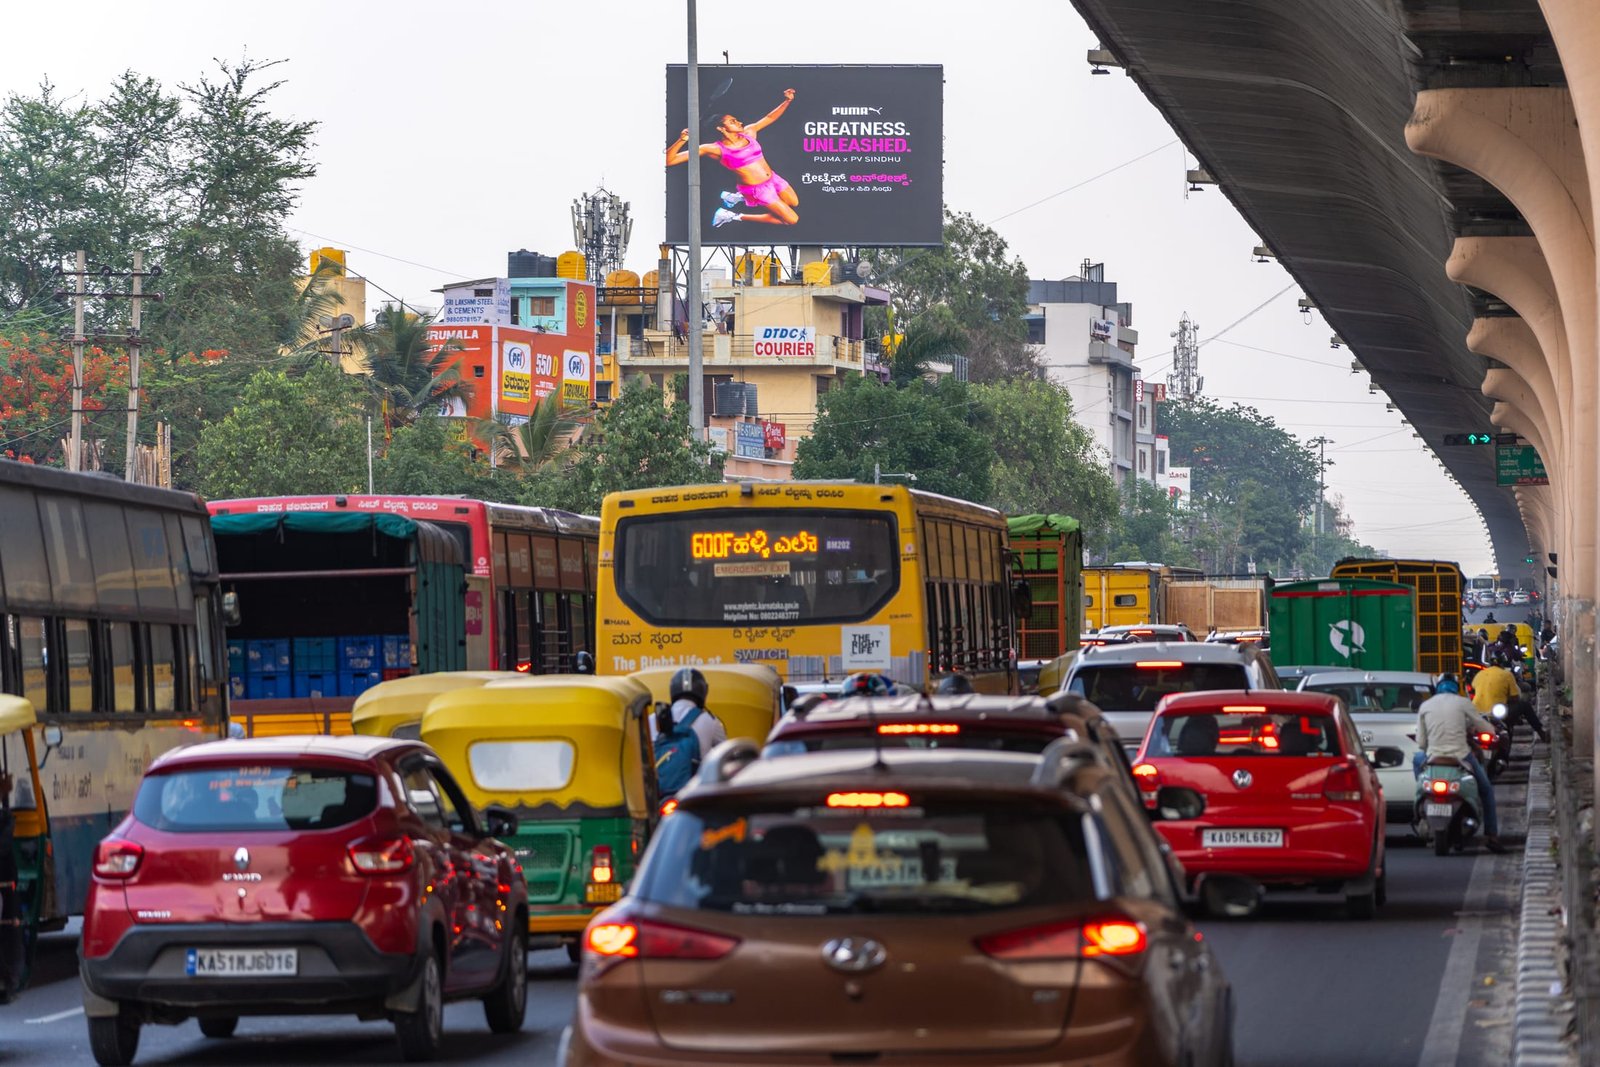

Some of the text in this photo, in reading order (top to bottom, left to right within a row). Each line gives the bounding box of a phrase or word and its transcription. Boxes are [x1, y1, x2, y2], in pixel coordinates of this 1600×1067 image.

[832, 106, 868, 115] PUMA
[804, 121, 911, 136] GREATNESS.
[803, 138, 912, 152] UNLEASHED.
[426, 330, 479, 340] IRUMALA
[763, 328, 799, 339] DTDC
[755, 342, 815, 356] COURIER
[692, 532, 734, 558] 600F
[826, 540, 850, 549] BM202
[715, 563, 788, 574] EMERGENCY EXIT
[724, 612, 747, 622] Helpline
[612, 634, 642, 645] ಮನ
[851, 640, 880, 648] RIGHT
[734, 649, 788, 660] SWITCH
[851, 647, 873, 655] LIFE
[613, 656, 636, 671] The
[1211, 832, 1281, 843] KA05ML6627
